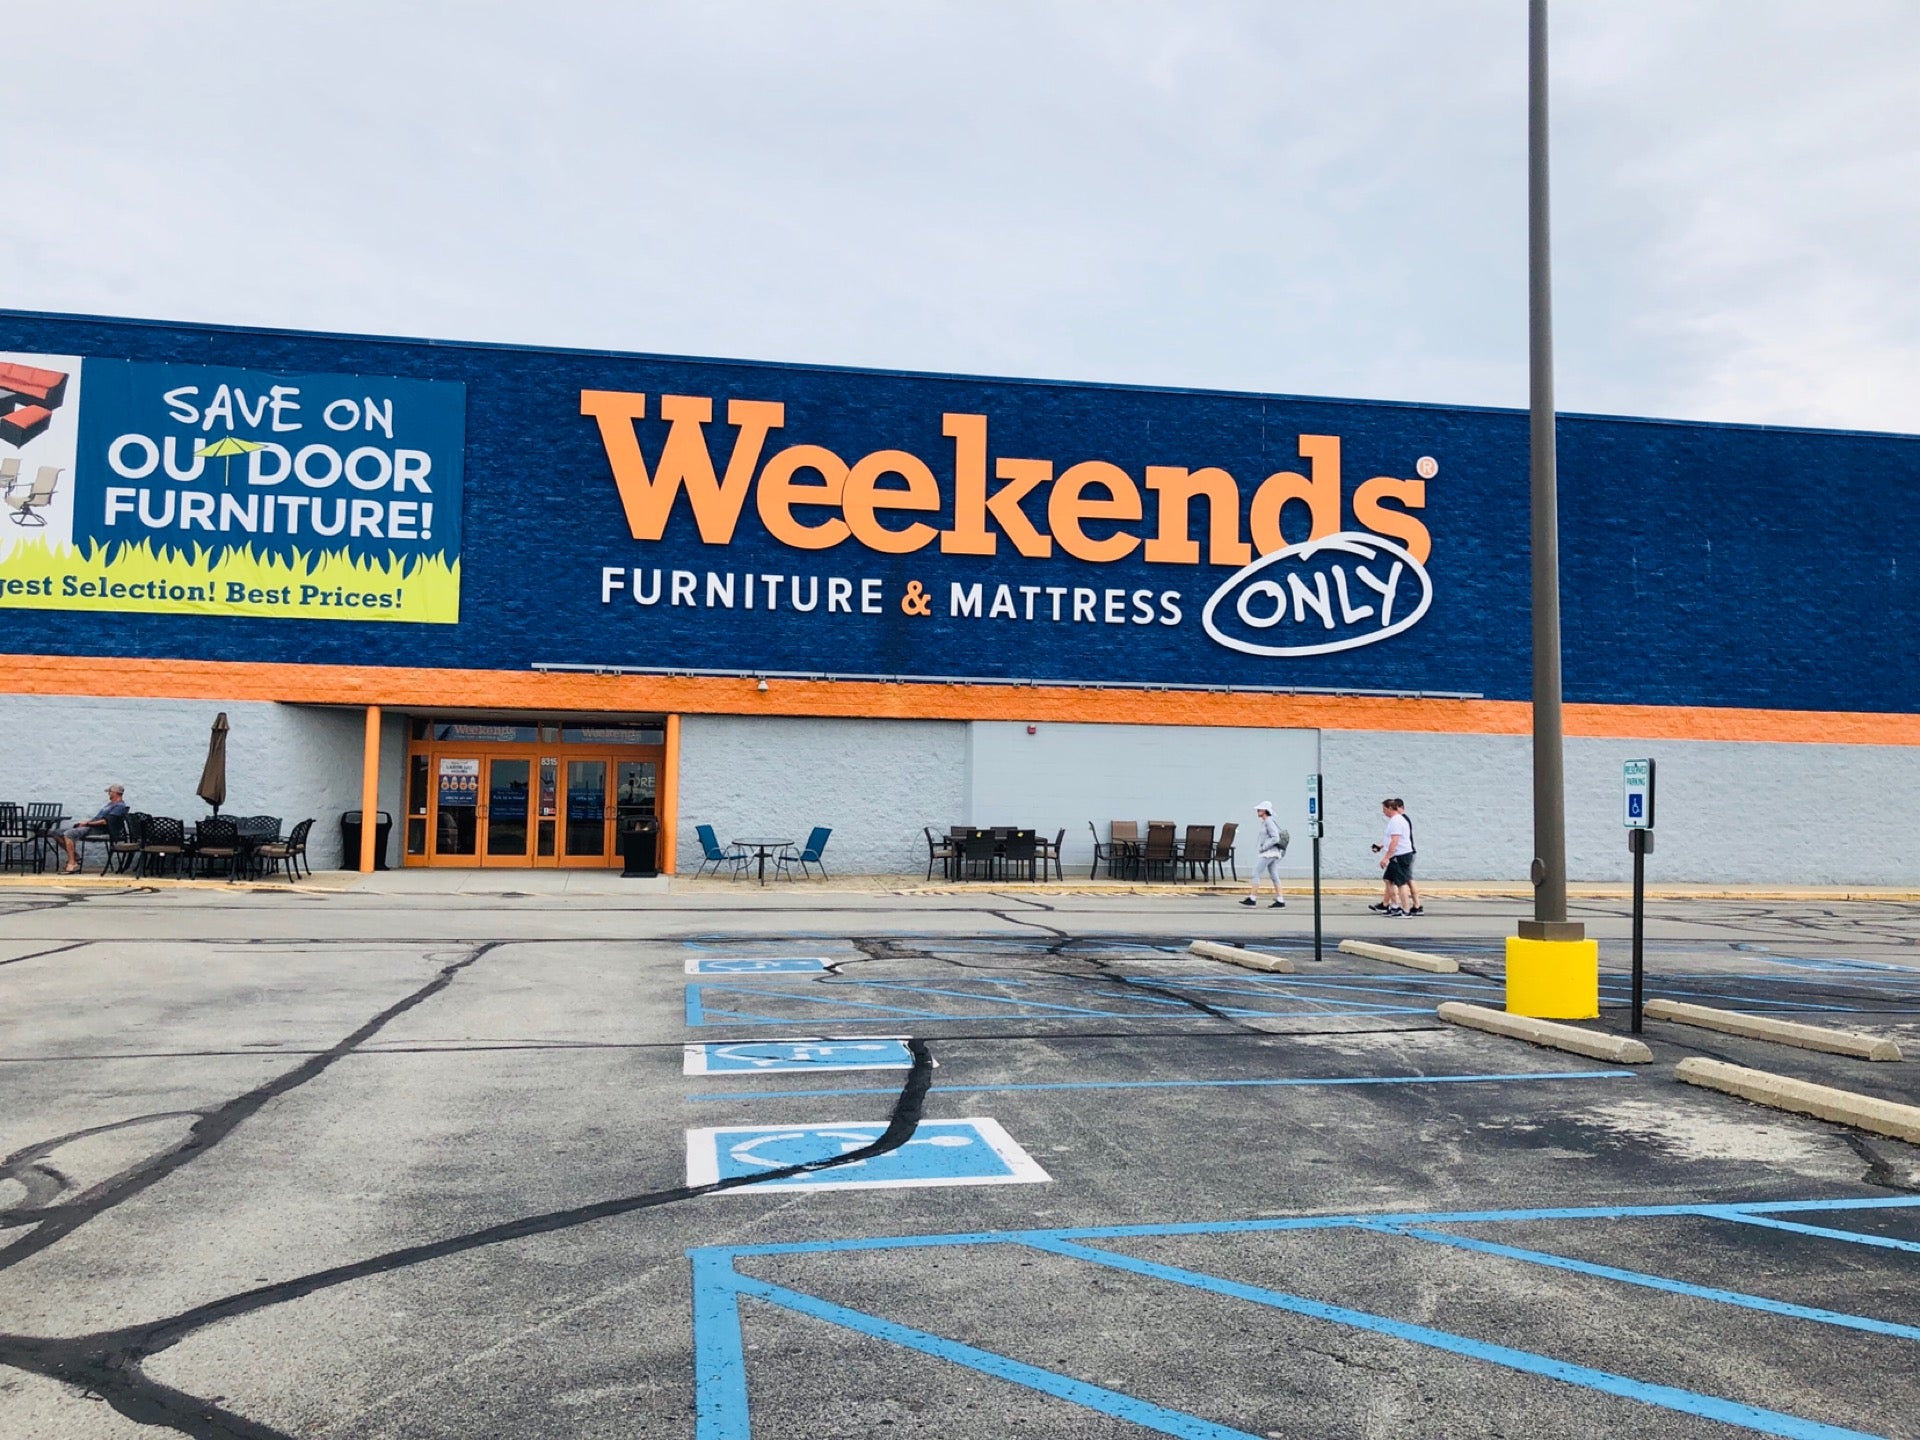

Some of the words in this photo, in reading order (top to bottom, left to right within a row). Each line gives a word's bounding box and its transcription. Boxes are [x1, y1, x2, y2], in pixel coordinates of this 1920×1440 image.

[163, 384, 303, 432] SAVE
[323, 397, 395, 439] ON
[580, 389, 1432, 566] Weekends
[104, 487, 434, 539] FURNITURE!
[62, 575, 216, 602] Selection!
[226, 582, 292, 605] Best
[299, 586, 402, 609] Prices!
[601, 566, 884, 616] FURNITURE
[902, 580, 932, 617] &
[950, 582, 1183, 626] MATTRESS
[1236, 560, 1403, 629] ONLY
